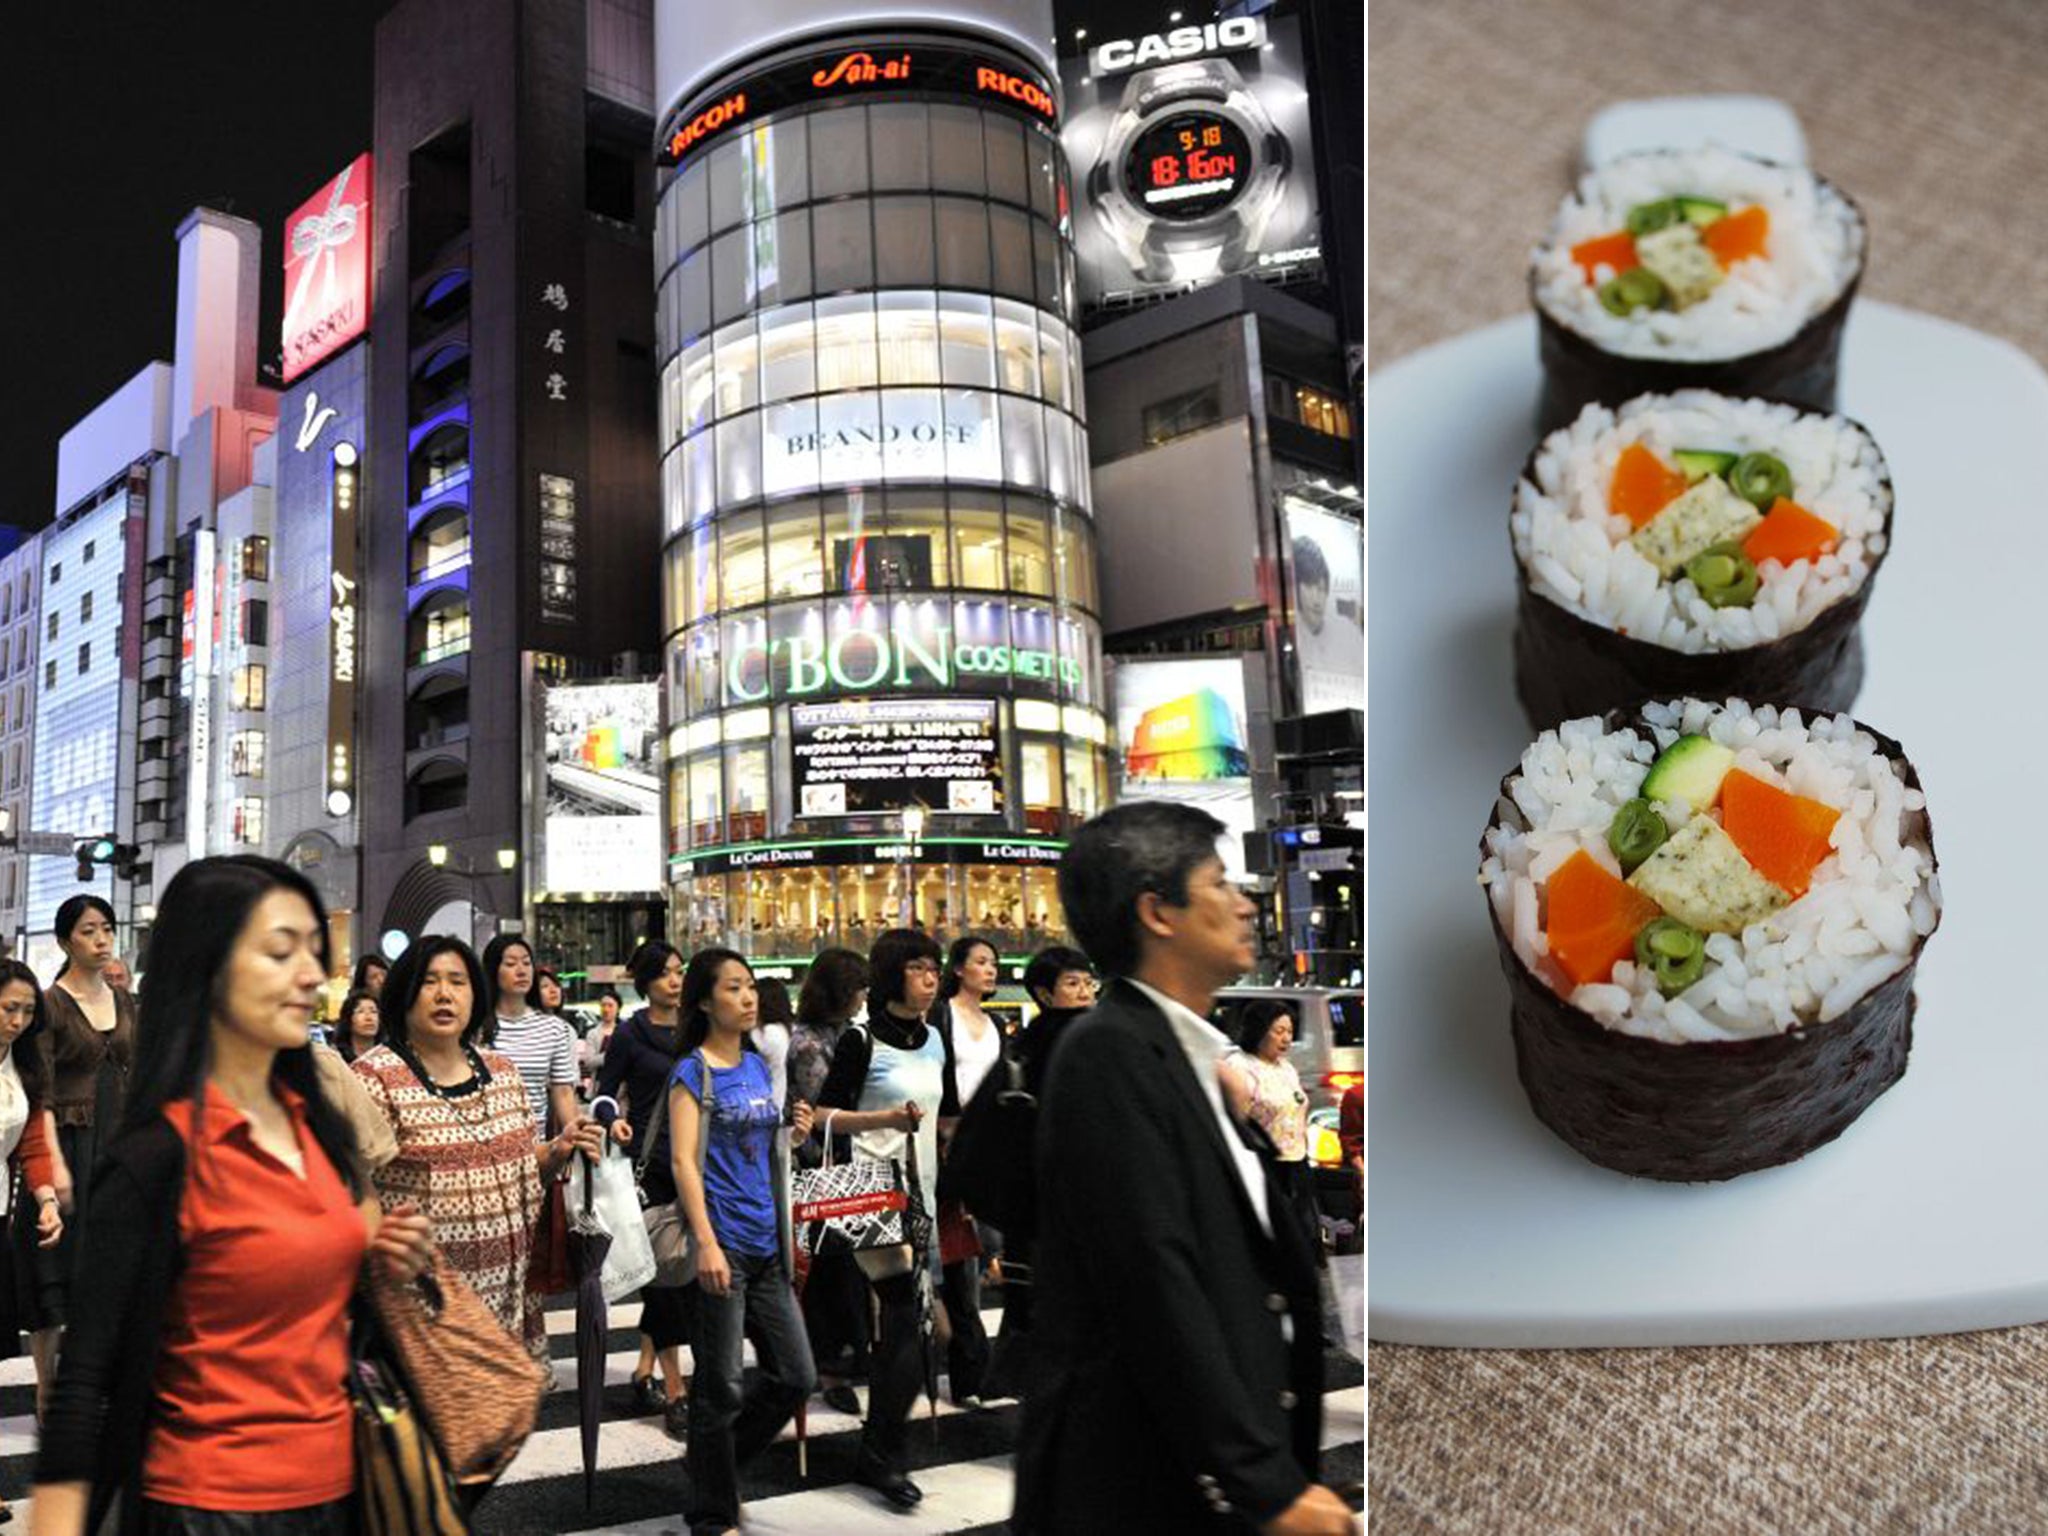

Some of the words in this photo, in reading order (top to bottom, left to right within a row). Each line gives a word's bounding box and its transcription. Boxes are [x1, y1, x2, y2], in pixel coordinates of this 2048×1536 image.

[1098, 16, 1257, 70] CASIO
[977, 67, 1054, 116] RICOH
[671, 94, 746, 156] RICOH
[787, 424, 900, 456] BRAND
